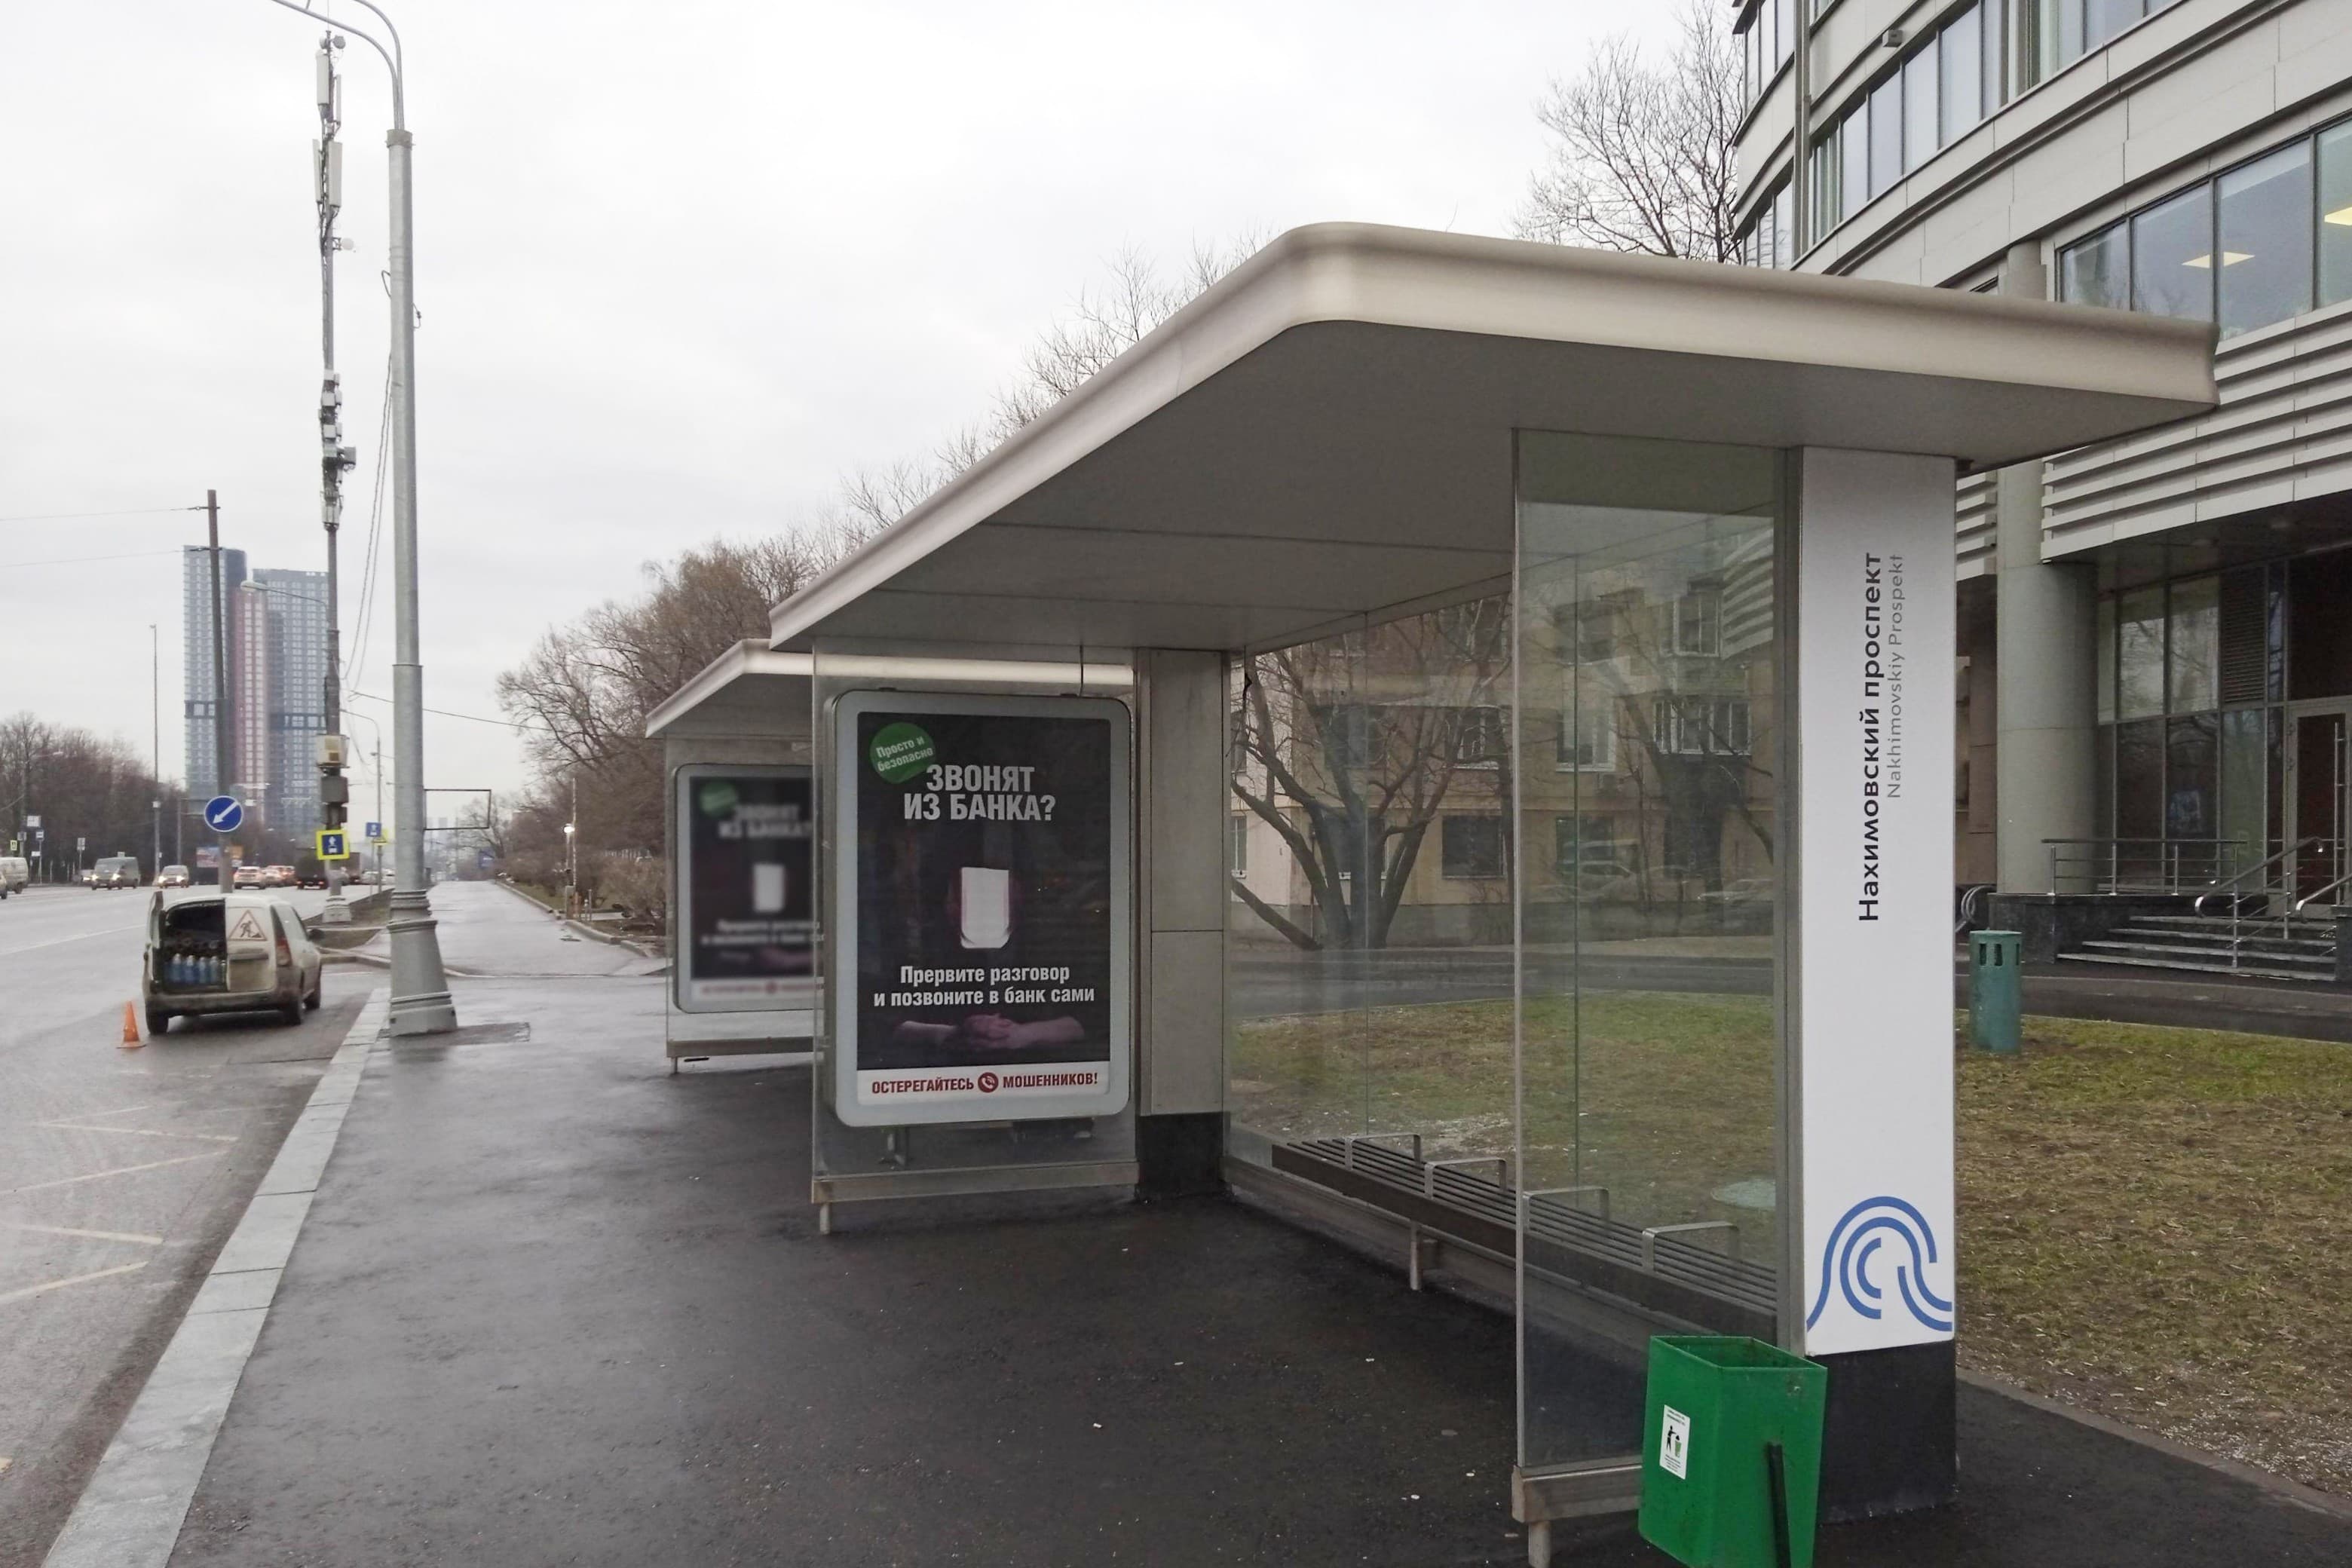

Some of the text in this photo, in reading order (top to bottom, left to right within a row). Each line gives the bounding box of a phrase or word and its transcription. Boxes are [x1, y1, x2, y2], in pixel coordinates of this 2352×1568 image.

[1887, 554, 1905, 799] Nakhimovskiy Prospekt
[876, 736, 925, 758] Просто и
[1858, 553, 1885, 921] Нахимовский проспект
[877, 747, 934, 772] безопасно
[926, 764, 1035, 792] ЗВОНЯТ
[904, 792, 1056, 821] ИЗ БАНКА?
[900, 965, 1070, 988] Прервите разговор
[874, 986, 1095, 1006] и позвоните в банк сами
[871, 1073, 1098, 1094] ОСТЕРЕГАЙТЕСЬ МОШЕННИКОВ!
